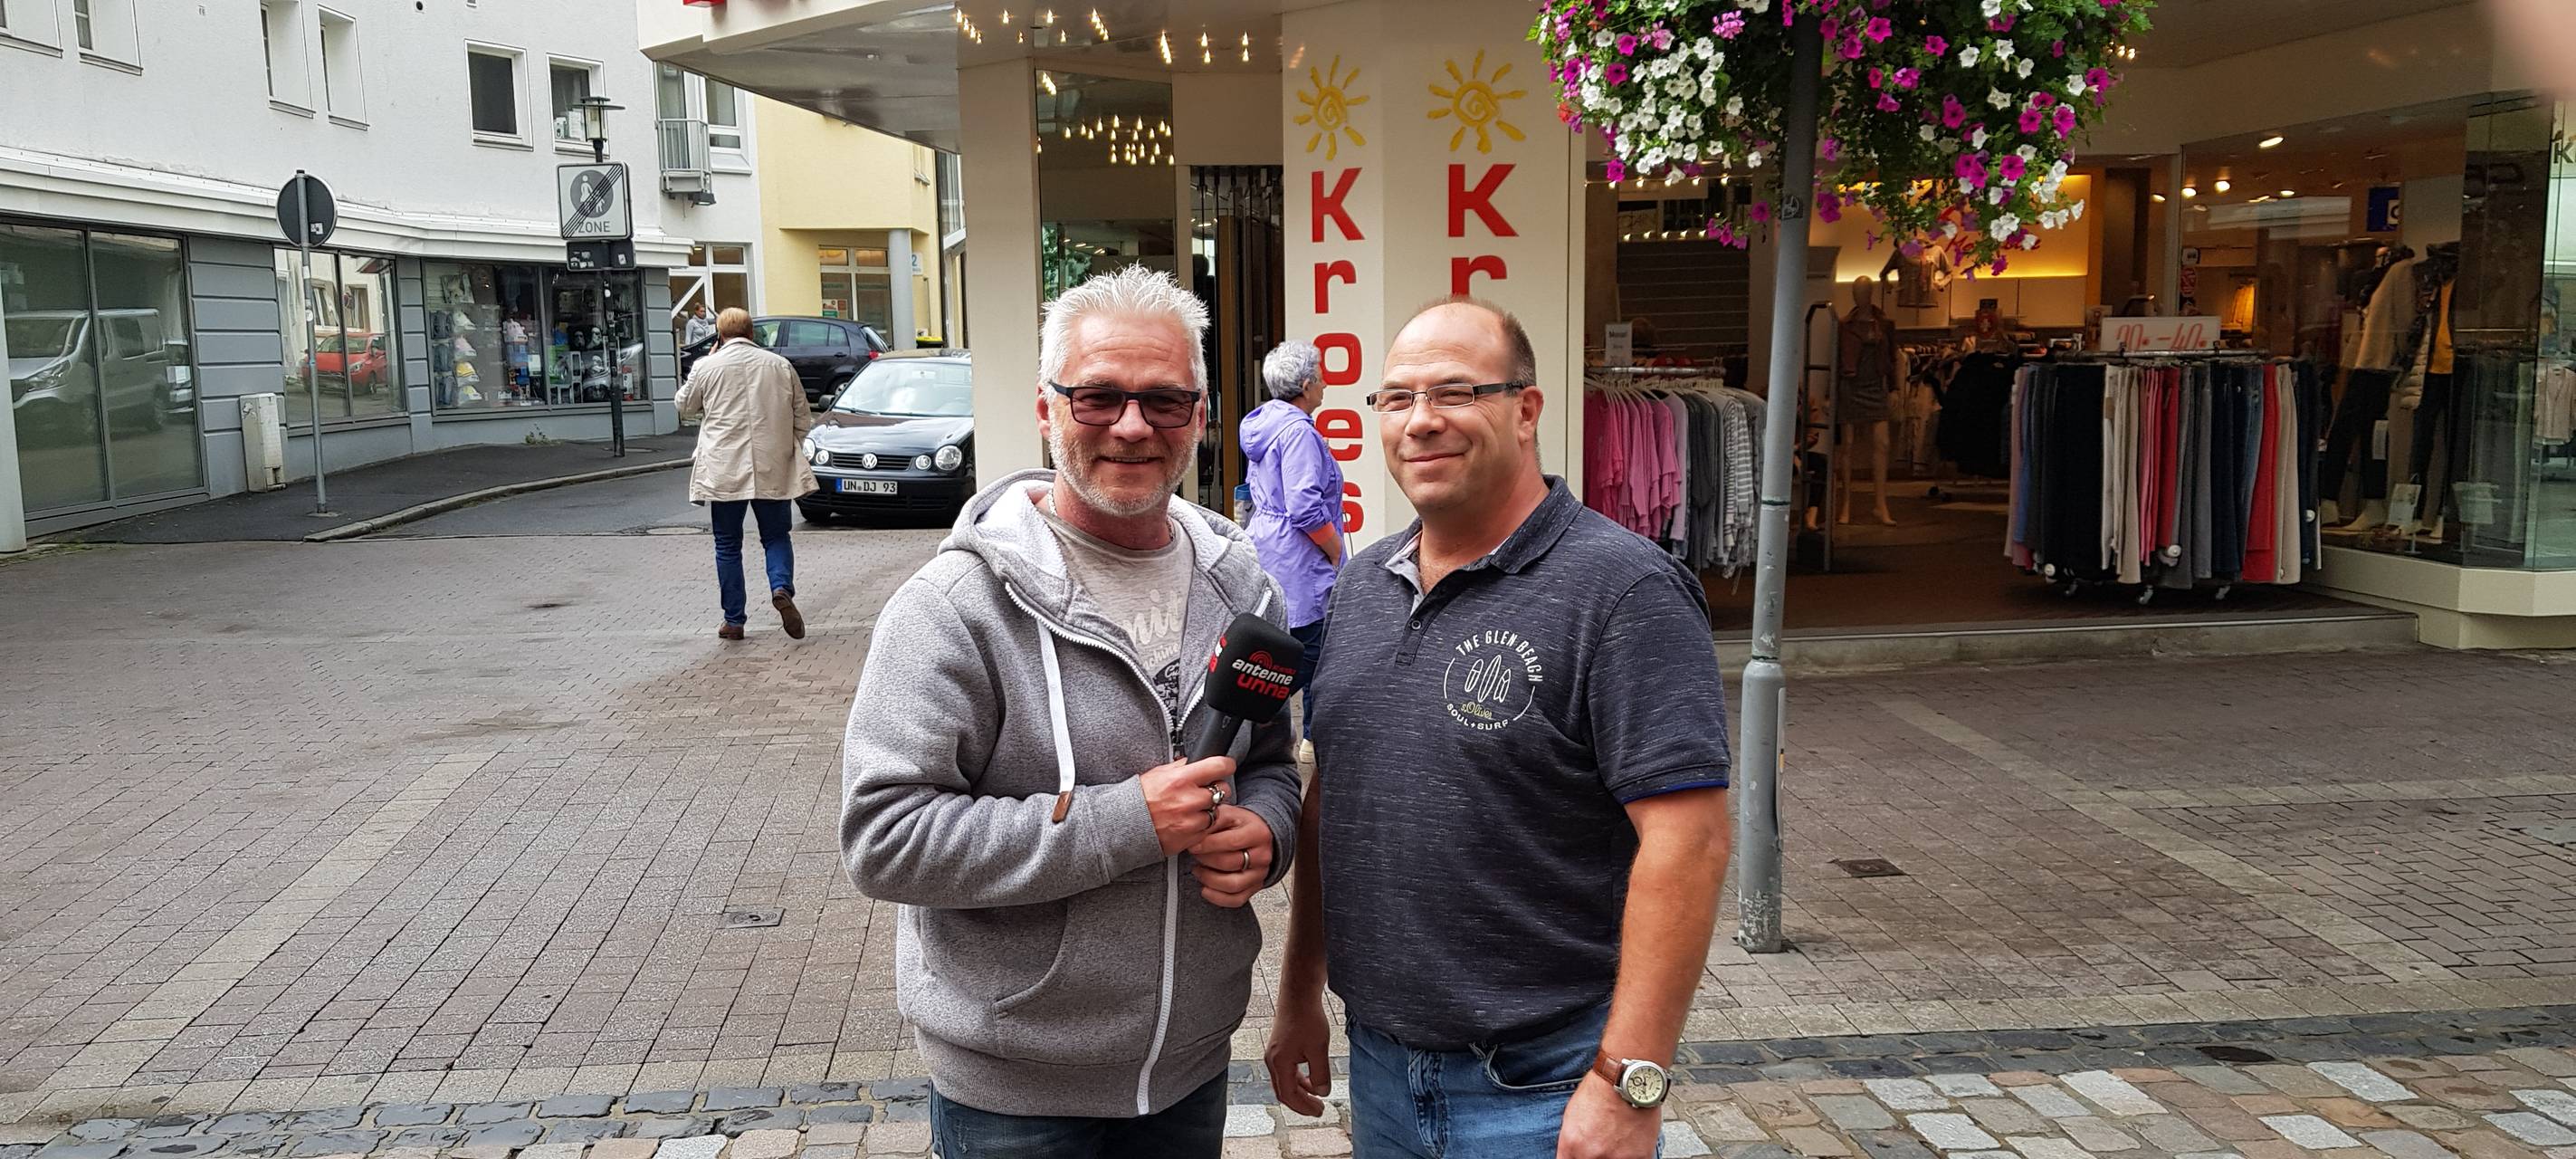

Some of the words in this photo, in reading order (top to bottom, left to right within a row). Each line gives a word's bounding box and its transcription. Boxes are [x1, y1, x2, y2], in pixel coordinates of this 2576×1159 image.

[578, 220, 611, 234] ZONE
[844, 480, 857, 491] UN
[863, 481, 877, 492] DJ
[883, 482, 896, 493] 93
[1455, 634, 1480, 656] THE
[1485, 629, 1518, 647] GLEN
[1515, 639, 1543, 682] BEACH
[1232, 658, 1293, 685] antenne
[1236, 672, 1290, 700] unna
